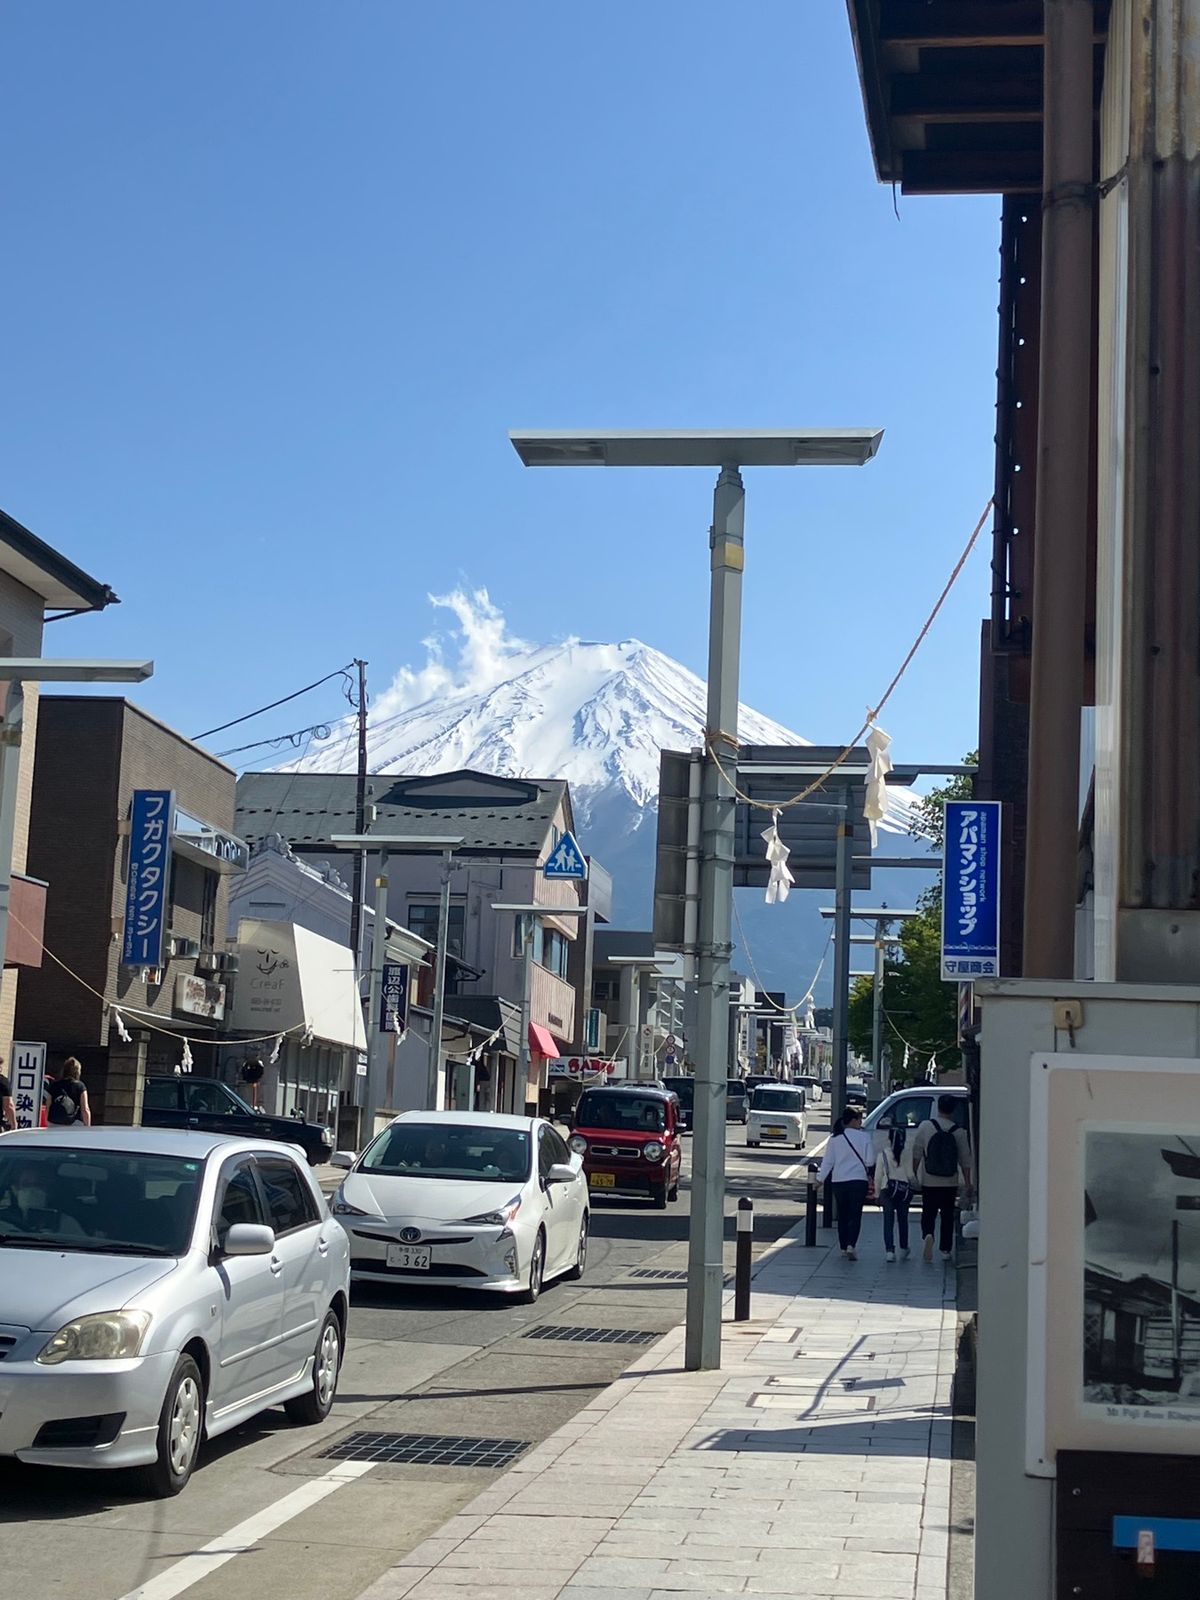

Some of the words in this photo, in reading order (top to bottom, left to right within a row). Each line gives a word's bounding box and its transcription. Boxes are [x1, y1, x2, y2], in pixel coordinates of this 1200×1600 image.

[959, 810, 978, 936] アパマンショップ
[980, 847, 988, 867] shop
[137, 797, 164, 959] フガクタクシー
[979, 869, 987, 902] network
[944, 961, 994, 974] 守屋商会
